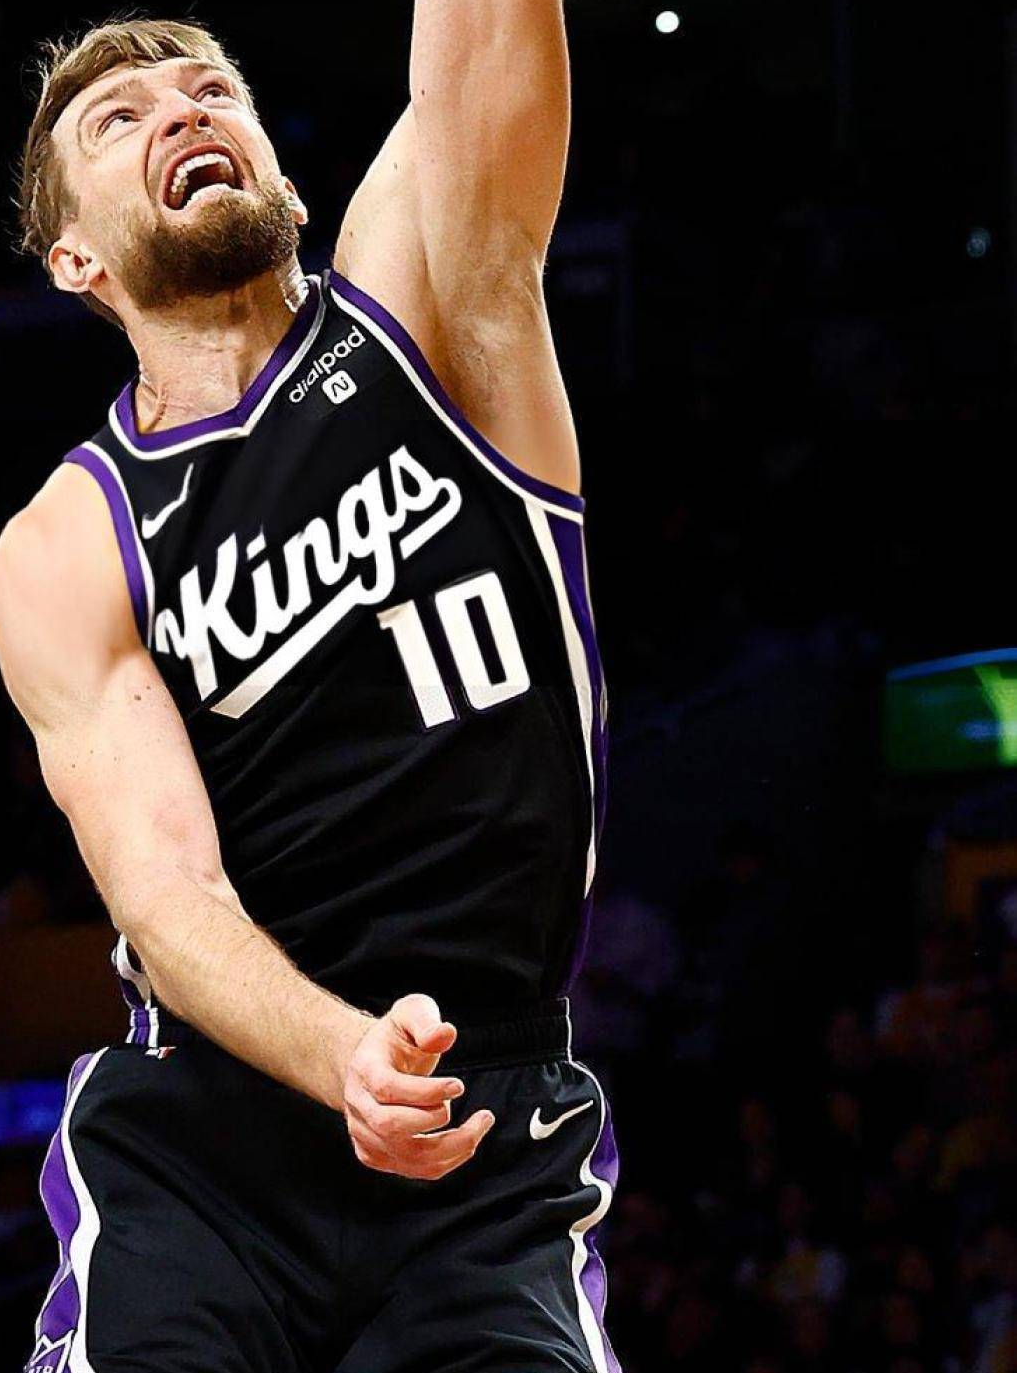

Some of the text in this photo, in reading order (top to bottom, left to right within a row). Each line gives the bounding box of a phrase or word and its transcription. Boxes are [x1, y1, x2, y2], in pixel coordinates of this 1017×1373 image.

[288, 325, 366, 403] dialpad
[154, 444, 462, 718] Kings
[377, 569, 531, 729] 10
